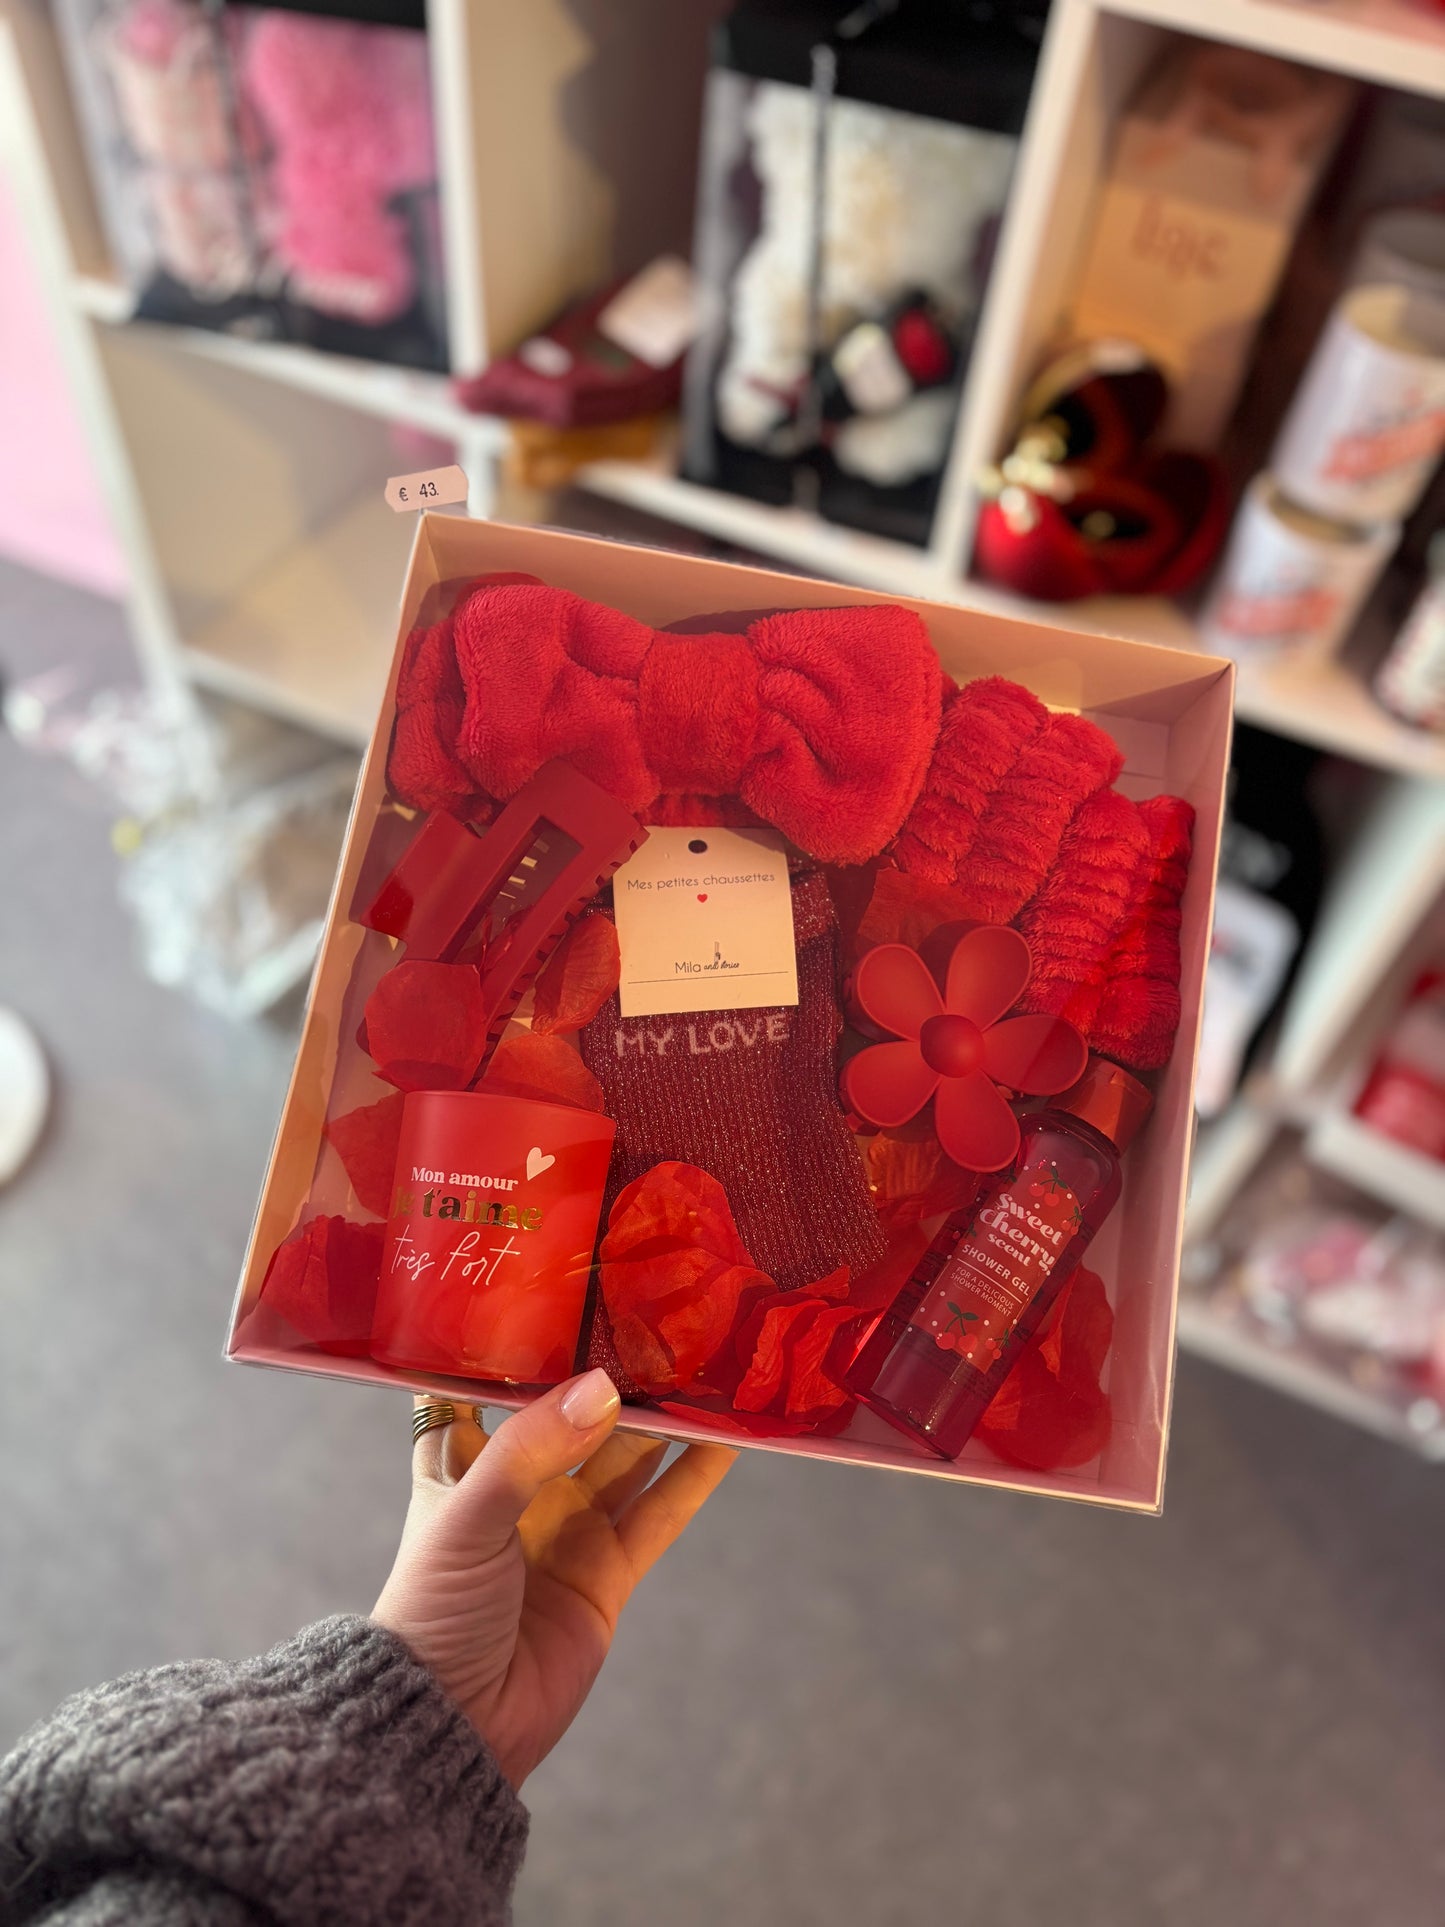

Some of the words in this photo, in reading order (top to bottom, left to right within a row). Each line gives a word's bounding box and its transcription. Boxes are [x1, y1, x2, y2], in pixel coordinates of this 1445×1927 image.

[399, 487, 408, 502] €
[627, 879, 652, 890] Mes
[657, 877, 699, 891] petites
[702, 872, 775, 887] chaussettes
[675, 961, 701, 974] Mila
[615, 1028, 674, 1058] MY
[687, 1013, 790, 1054] LOVE
[411, 1166, 445, 1184] Mon
[449, 1172, 519, 1191] amour
[422, 1187, 544, 1231] t'aime
[996, 1193, 1063, 1246] Sweet
[391, 1224, 435, 1281] très
[440, 1231, 521, 1286] fort
[962, 1244, 1011, 1280] SHOWER
[1011, 1276, 1031, 1297] GEL
[988, 1233, 1031, 1267] scent
[951, 1272, 981, 1296] SHOWER
[980, 1292, 1012, 1317] MOMENT
[956, 1267, 971, 1281] FOR
[977, 1280, 1015, 1310] DELICIOUS
